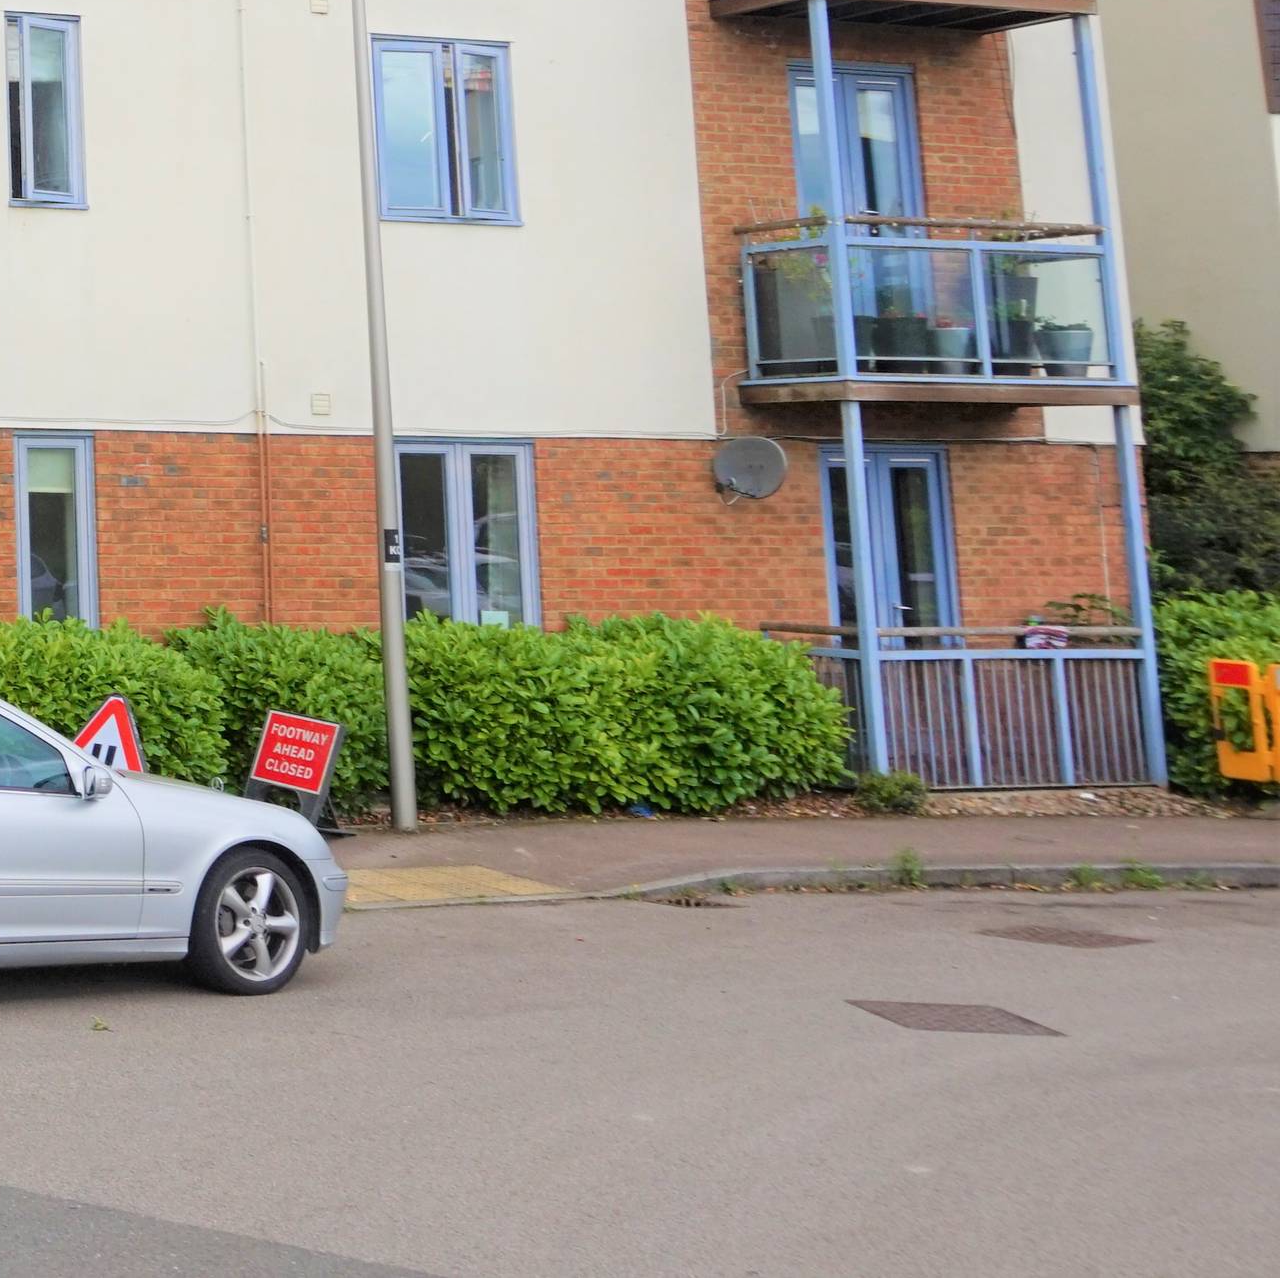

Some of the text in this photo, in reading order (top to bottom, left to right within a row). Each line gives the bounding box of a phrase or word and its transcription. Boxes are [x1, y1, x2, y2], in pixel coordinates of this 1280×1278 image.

[271, 723, 329, 746] FOOTWAY
[272, 742, 315, 761] AHEAD
[265, 758, 314, 779] CLOSED
